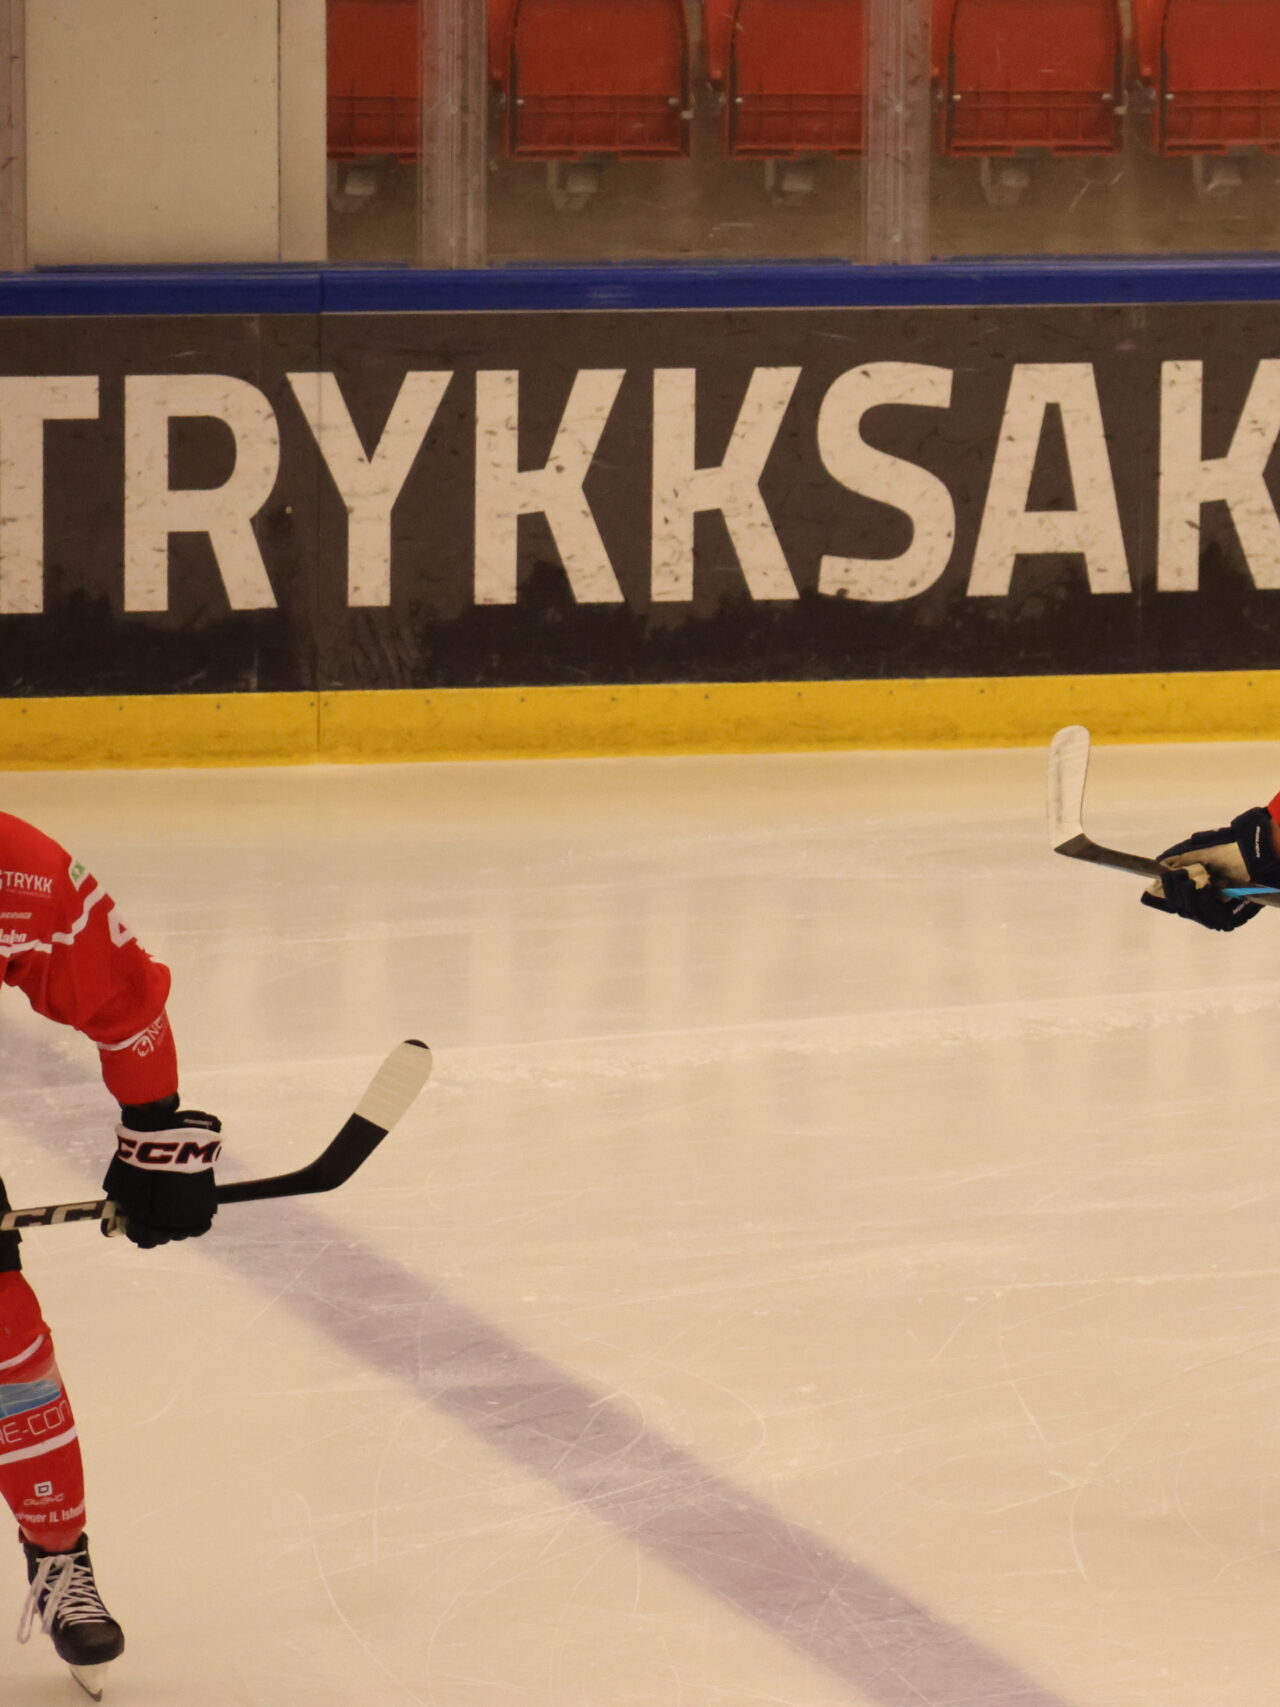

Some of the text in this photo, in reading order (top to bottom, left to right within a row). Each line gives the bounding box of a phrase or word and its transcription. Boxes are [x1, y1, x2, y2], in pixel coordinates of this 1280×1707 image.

[4, 871, 53, 893] TRYKK
[118, 1136, 220, 1164] CCM
[1, 1201, 100, 1230] CC
